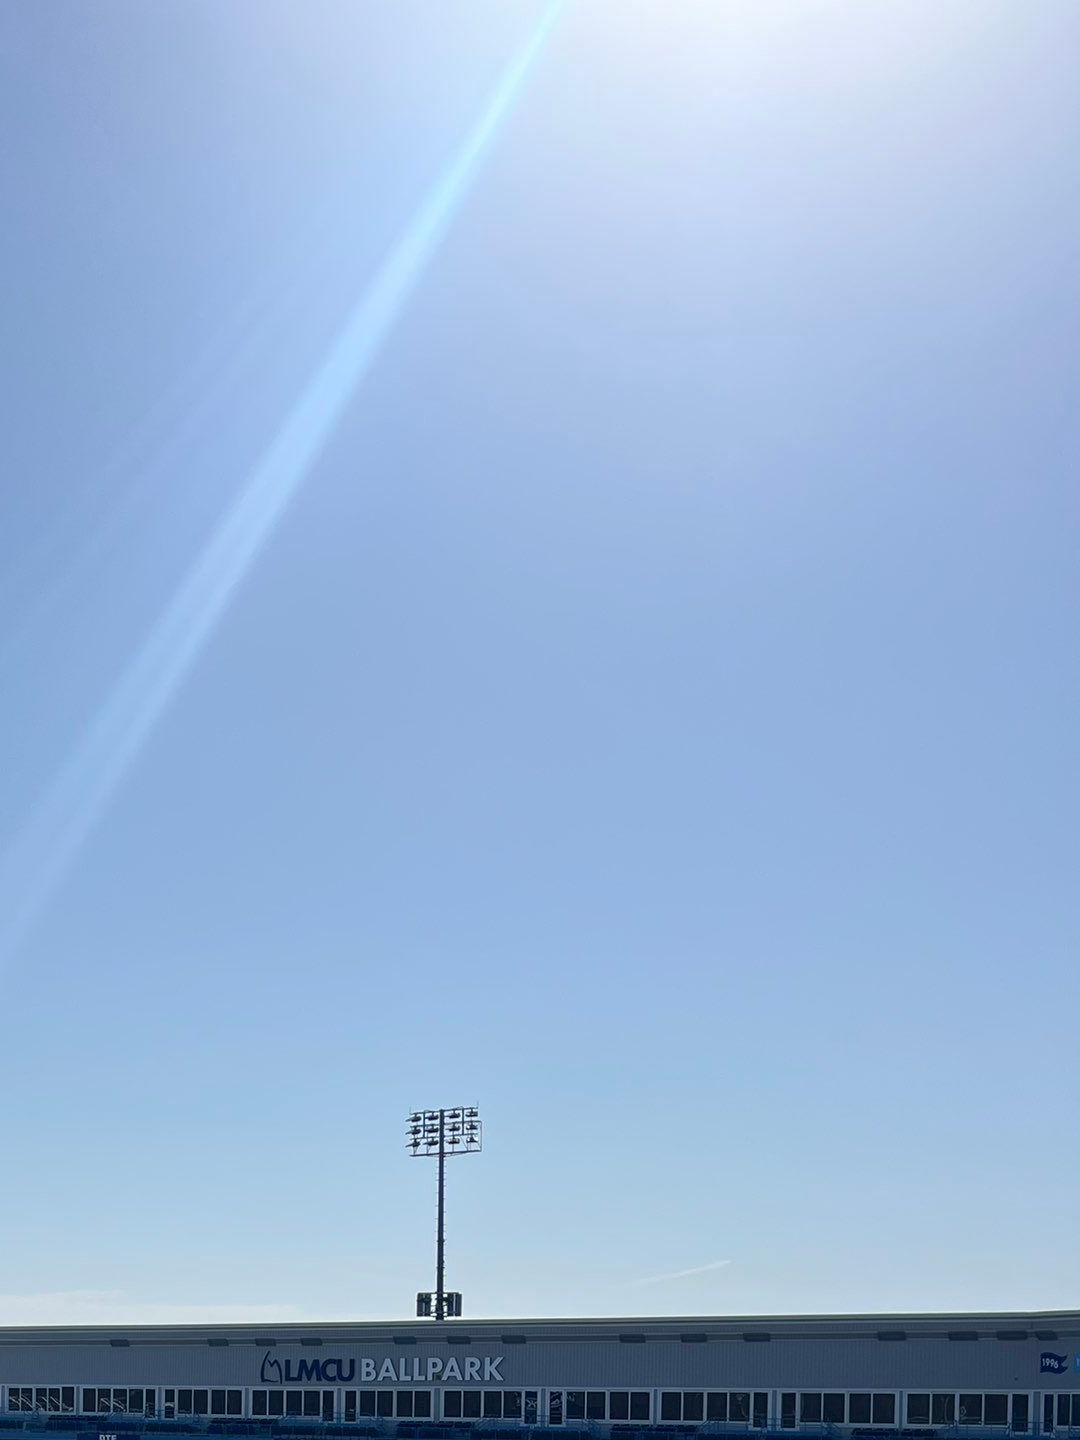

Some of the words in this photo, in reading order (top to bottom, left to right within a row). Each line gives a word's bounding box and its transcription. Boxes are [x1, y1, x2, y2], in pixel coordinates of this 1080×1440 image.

[284, 1358, 355, 1382] LMCU
[360, 1356, 504, 1382] BALLPARK
[1042, 1358, 1059, 1369] 1996
